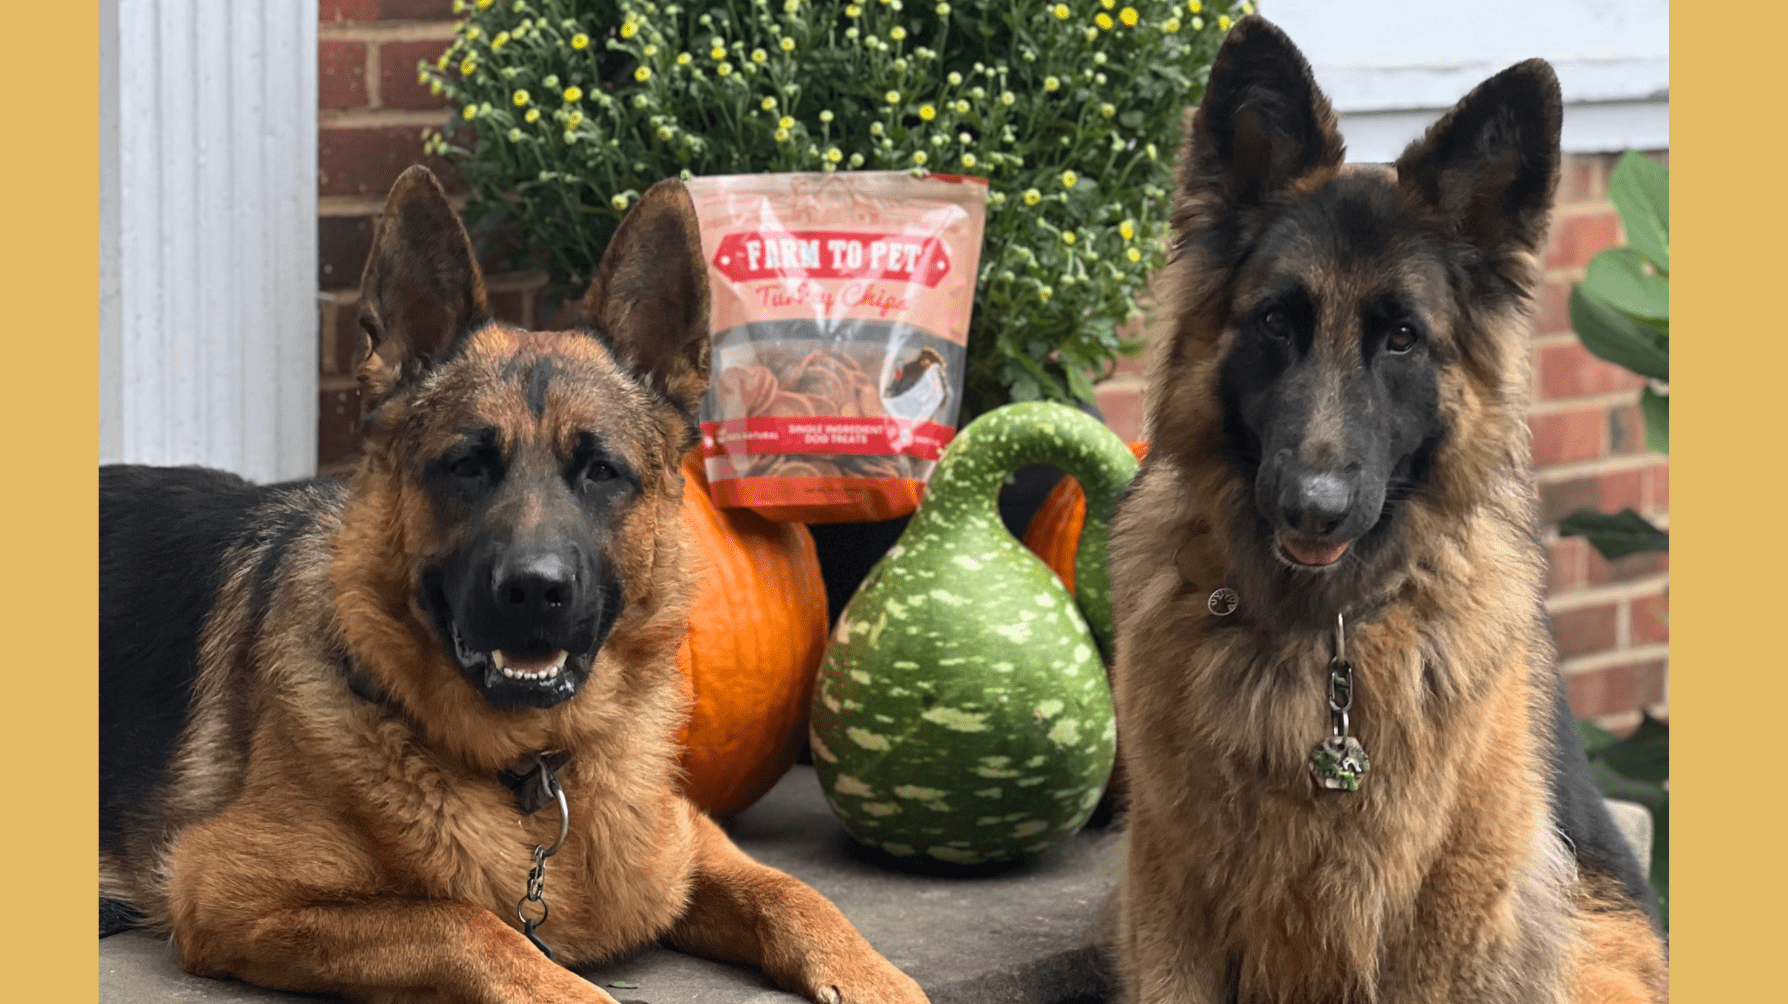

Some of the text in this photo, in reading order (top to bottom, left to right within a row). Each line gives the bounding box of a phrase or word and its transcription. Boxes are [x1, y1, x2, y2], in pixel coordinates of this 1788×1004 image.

[746, 239, 922, 272] FARM TO PET
[755, 282, 832, 317] Turky
[804, 434, 829, 444] DOG
